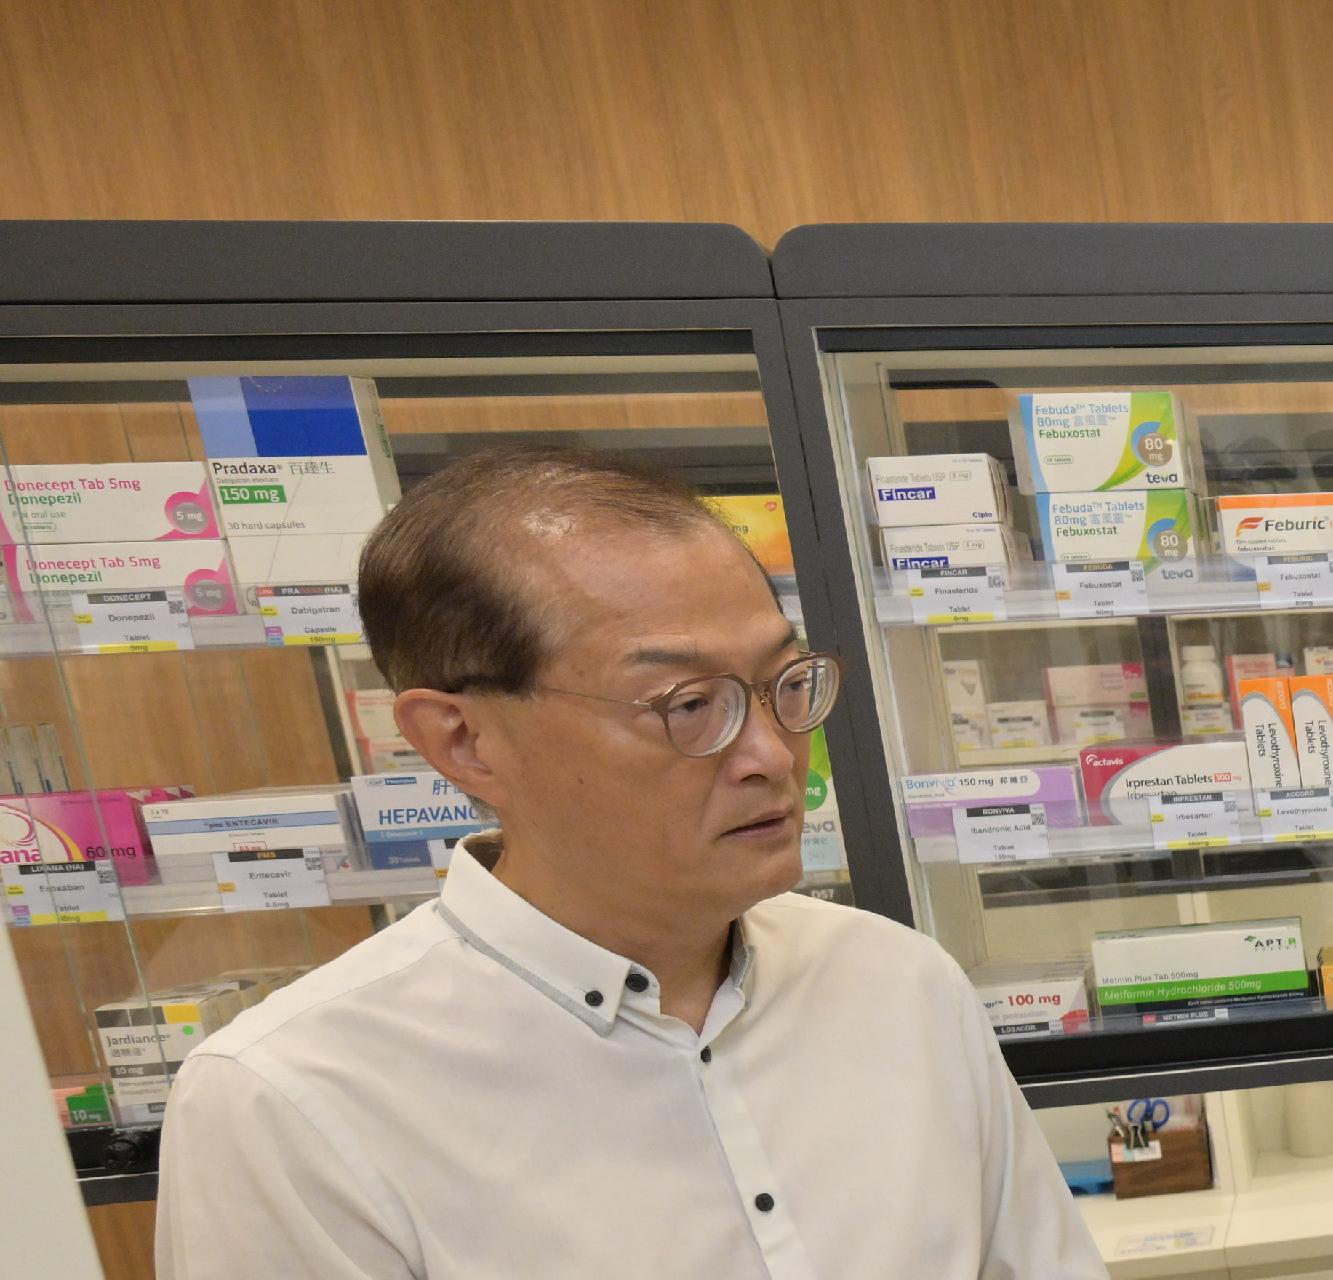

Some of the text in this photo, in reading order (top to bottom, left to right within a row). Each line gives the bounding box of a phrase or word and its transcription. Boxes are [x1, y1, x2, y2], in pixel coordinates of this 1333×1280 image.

[1088, 402, 1129, 413] Tablets
[1037, 417, 1070, 428] 80mg
[1039, 429, 1101, 439] Febuxostat
[1144, 439, 1163, 450] 80
[1149, 453, 1163, 461] mg
[1145, 472, 1178, 483] teva
[5, 478, 141, 492] Donecept Tab 5mg
[8, 493, 81, 505] Donepezil
[222, 488, 279, 502] 150 mg
[882, 488, 932, 500] Fincar
[1105, 501, 1145, 512] Tablets
[31, 510, 48, 518] oral
[187, 513, 203, 522] mg
[242, 522, 263, 530] hard
[265, 521, 305, 531] capsules
[1054, 515, 1087, 527] 80mg
[1056, 526, 1118, 537] Febuxostat
[1160, 535, 1179, 546] 80
[99, 557, 125, 569] Tab
[129, 557, 161, 569] 5mg
[896, 558, 945, 569] Fincar
[1083, 563, 1113, 571] FEBUDA
[1161, 568, 1194, 580] teva
[1079, 581, 1122, 589] Febuxostat
[104, 593, 151, 601] DONECEPT
[291, 607, 340, 615] Dabigatran
[108, 614, 155, 622] Donepezil
[1255, 724, 1266, 757] Tablets
[1304, 720, 1316, 754] Tablets
[1268, 723, 1282, 788] Levothyroxine
[1317, 720, 1332, 785] Levothyroxine
[1093, 757, 1124, 767] actavis
[978, 779, 994, 788] mg
[1126, 774, 1213, 789] Irprestan Tablets
[805, 787, 821, 796] mg
[1286, 790, 1314, 798] ACCORD
[1175, 812, 1213, 820] Irbesartan
[1276, 807, 1327, 815] Levothyroxine
[970, 827, 1013, 835] Ibandronic
[86, 846, 136, 858] 60 mg
[67, 864, 85, 872] (HA)
[249, 871, 291, 879] Entecavir
[263, 891, 288, 899] Tablet
[1102, 971, 1199, 985] Metmin Plus Tab 500mg
[1104, 988, 1154, 1001] Metformin
[1157, 983, 1226, 998] Hydrochloride
[1228, 979, 1262, 991] 500mg
[1008, 994, 1061, 1007] 100 mg
[1163, 1011, 1209, 1022] METMIN PLUS
[1001, 1025, 1036, 1033] LOSACOR
[115, 1067, 144, 1075] 10 mg
[72, 1110, 87, 1121] 10
